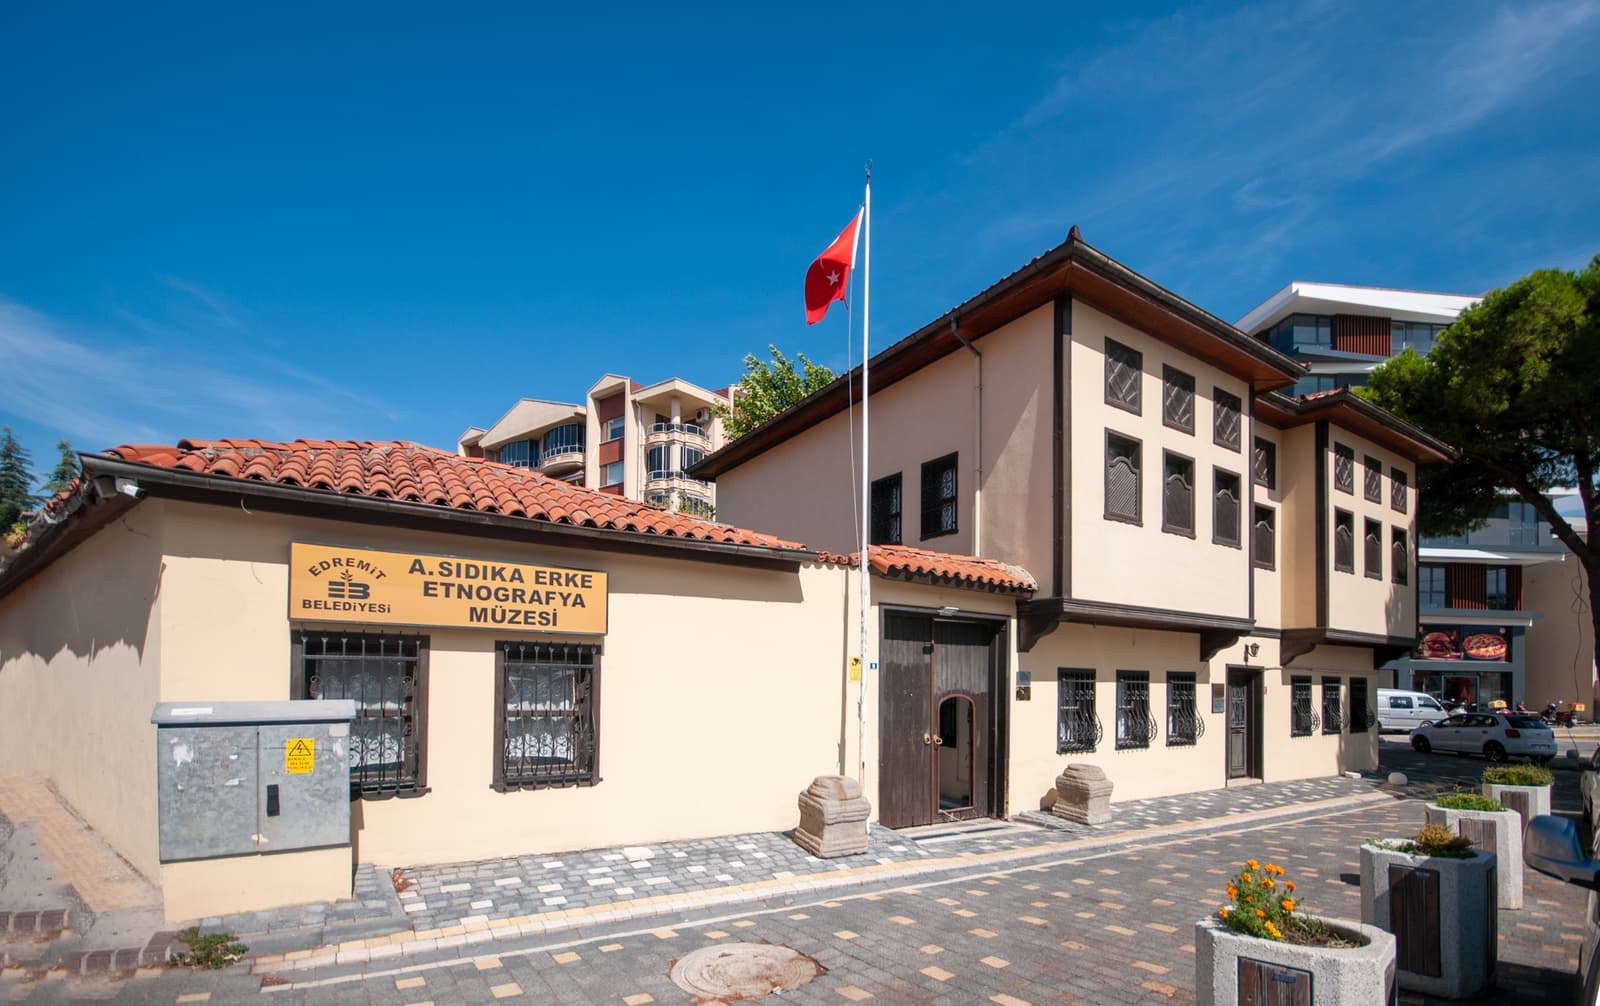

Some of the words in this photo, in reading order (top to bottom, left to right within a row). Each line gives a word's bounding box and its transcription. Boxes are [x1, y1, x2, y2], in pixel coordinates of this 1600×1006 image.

[408, 559, 525, 584] A.SIDIKA
[534, 570, 593, 589] ERKE
[423, 581, 586, 608] ETNOGRAFYA
[469, 605, 558, 627] MÜZESİ
